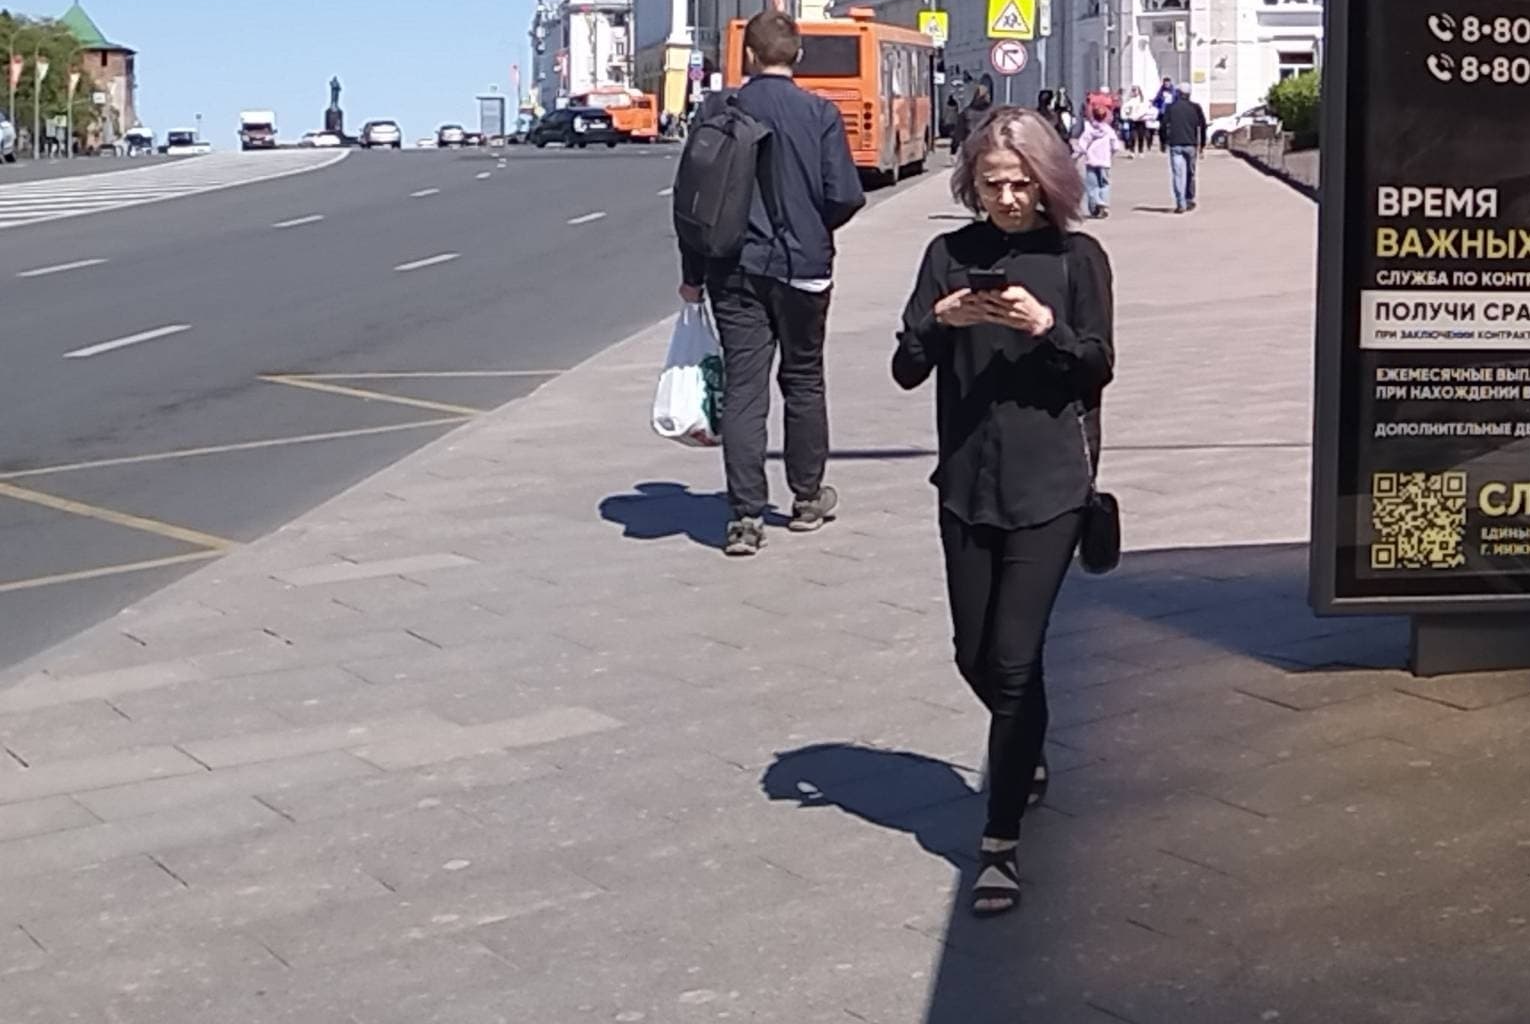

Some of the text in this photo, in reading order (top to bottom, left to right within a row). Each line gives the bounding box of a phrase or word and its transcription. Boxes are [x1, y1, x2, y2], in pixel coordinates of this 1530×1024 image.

[1377, 186, 1497, 218] ВРЕМЯ
[1376, 270, 1449, 287] СЛУЖБА
[1453, 272, 1478, 287] ПО
[1375, 302, 1475, 323] ПОЛУЧИ
[1375, 330, 1397, 339] ПРИ
[1376, 368, 1493, 381] ЕЖЕМЕСЯЧНЫЕ
[1376, 386, 1407, 400] ПРИ
[1410, 386, 1520, 401] НАХОЖДЕНИИ
[1374, 422, 1512, 438] ДОПОЛНИТЕЛЬНЫЕ
